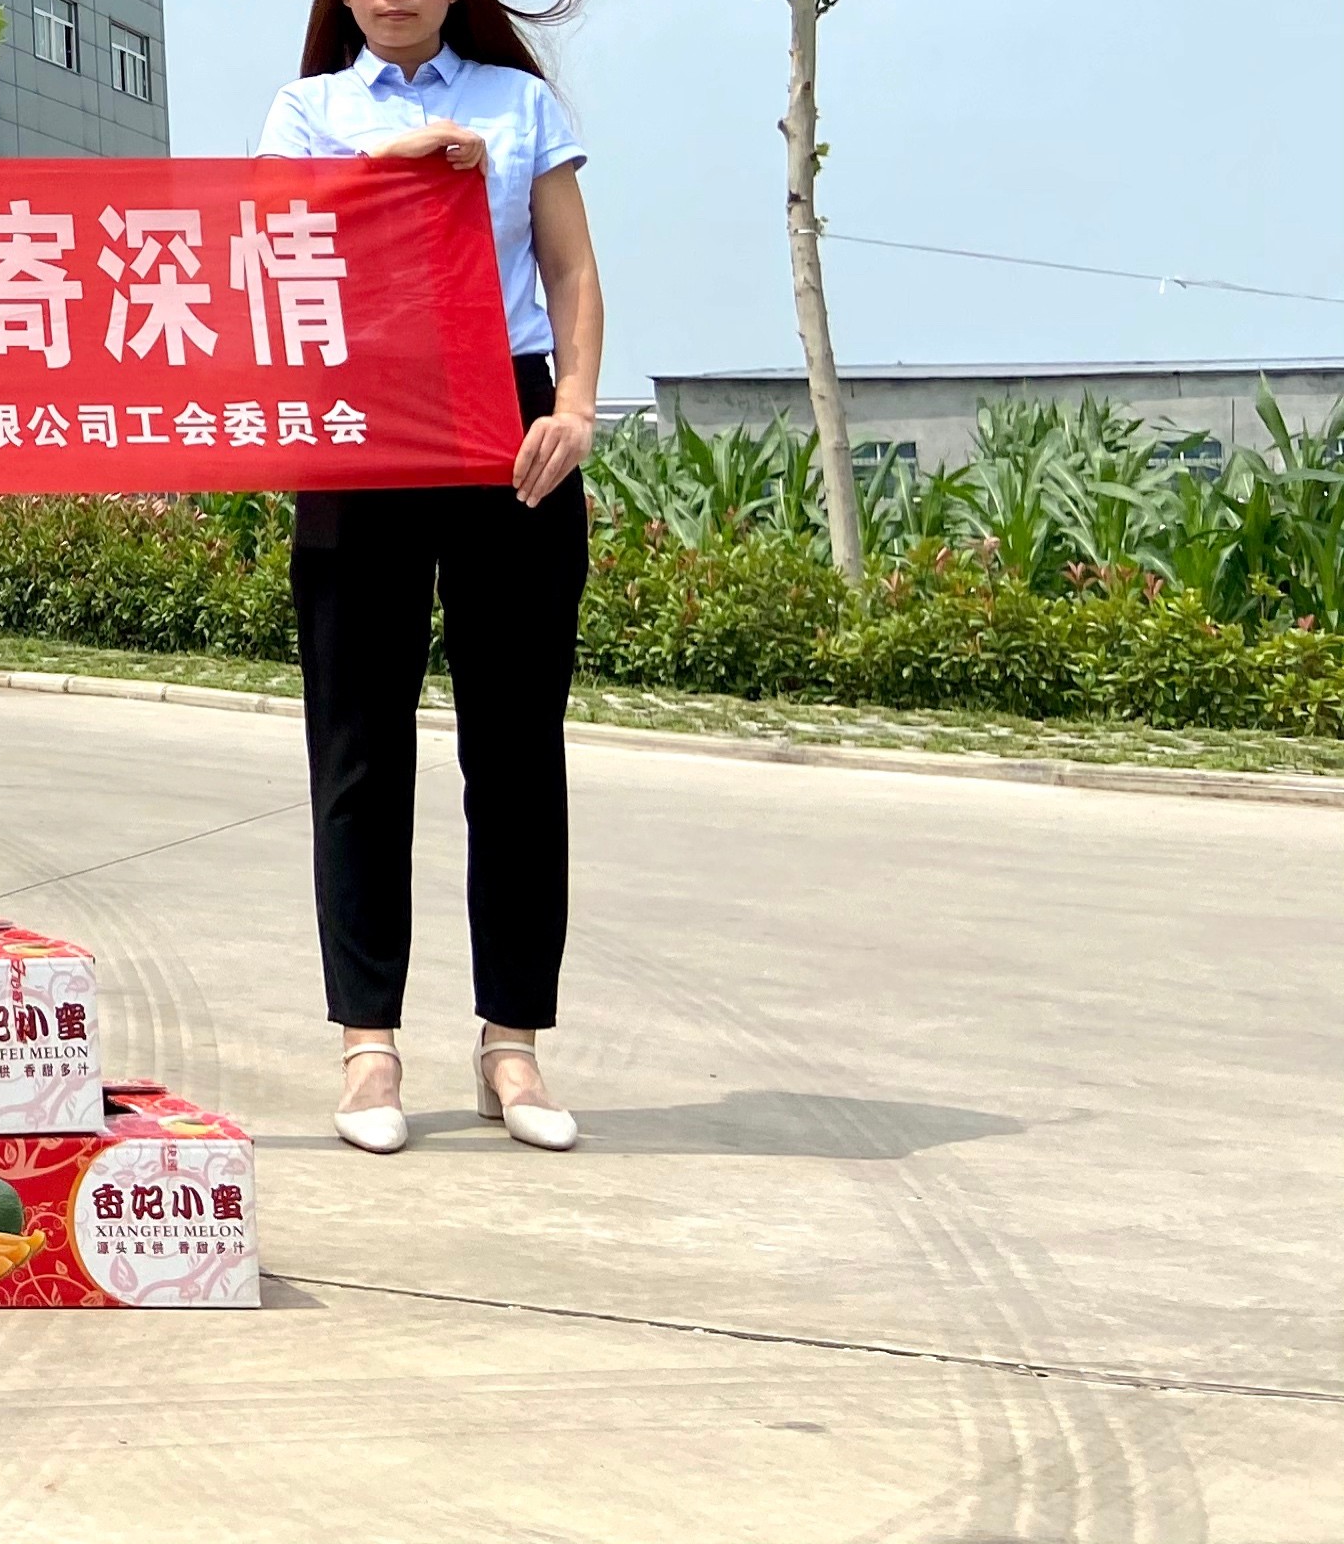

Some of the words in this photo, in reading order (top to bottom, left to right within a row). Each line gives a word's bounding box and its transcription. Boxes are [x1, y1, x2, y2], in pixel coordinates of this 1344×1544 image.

[30, 1045, 89, 1059] MELON
[24, 1062, 89, 1078] 香甜多汁
[92, 1183, 243, 1220] 香妃小蜜
[95, 1225, 179, 1238] XIANGFEI
[184, 1225, 245, 1238] MELON
[97, 1241, 164, 1255] 源头直供
[178, 1241, 245, 1255] 香甜多汁
